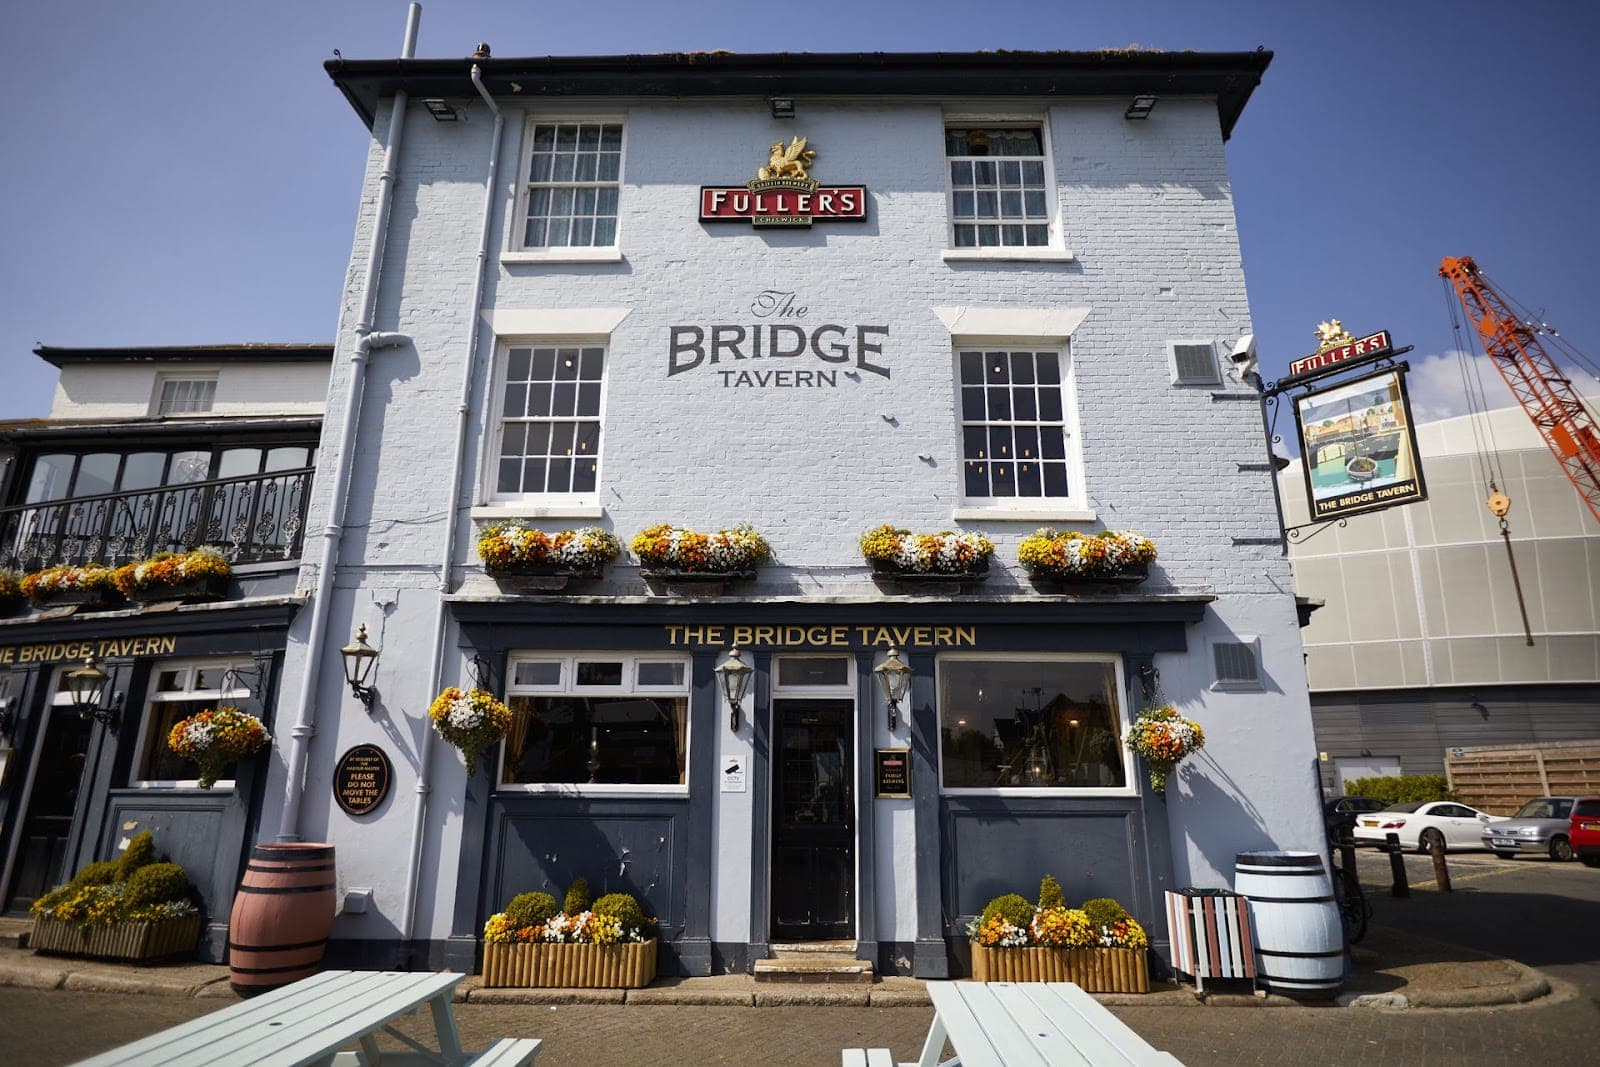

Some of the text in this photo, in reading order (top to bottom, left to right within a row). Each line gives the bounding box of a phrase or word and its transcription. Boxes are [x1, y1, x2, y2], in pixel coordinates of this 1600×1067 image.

[710, 190, 856, 214] FULLER'S
[750, 289, 809, 319] The
[666, 323, 891, 380] BRIDGE
[1296, 337, 1380, 374] FULLER'S
[717, 370, 838, 388] TAVERN
[1318, 484, 1414, 511] THE BRIDGE TAVERN
[19, 640, 95, 663] BRIDGE
[98, 635, 177, 657] TAVERN
[665, 626, 976, 646] THE BRIDGE TAVERN
